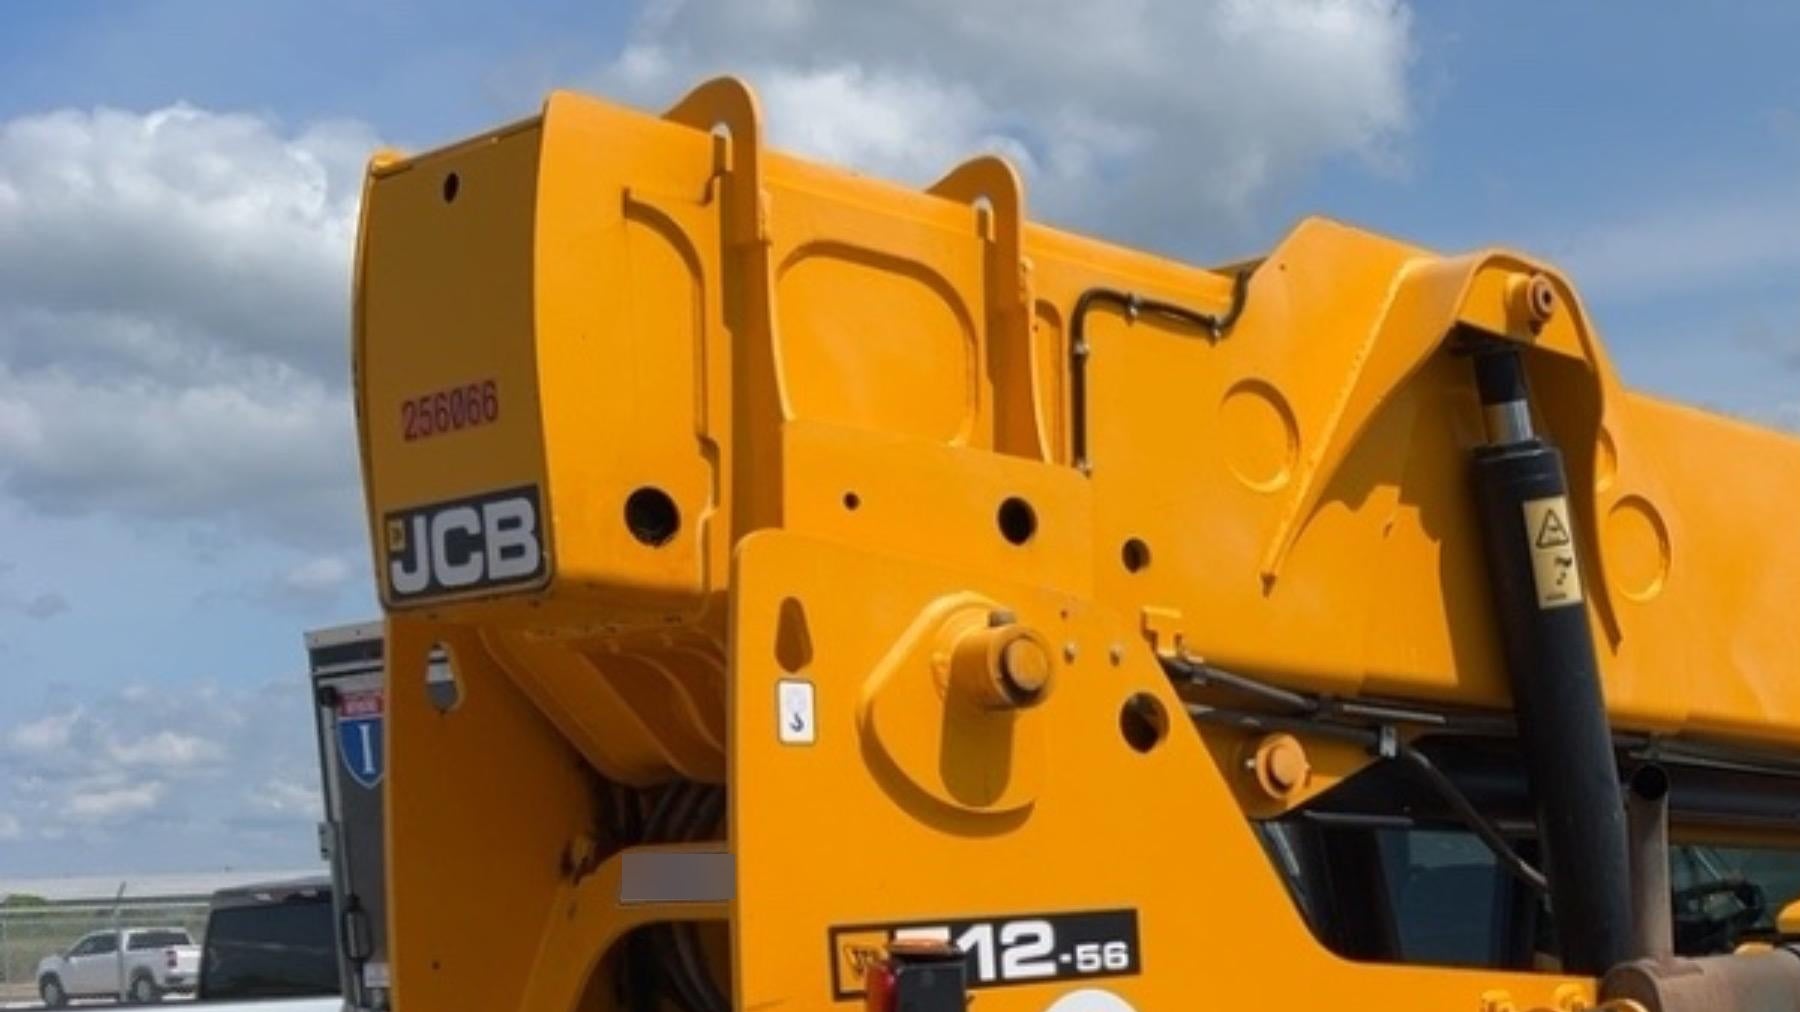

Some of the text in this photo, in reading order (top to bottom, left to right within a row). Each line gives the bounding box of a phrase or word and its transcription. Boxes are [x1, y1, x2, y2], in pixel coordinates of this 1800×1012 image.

[402, 379, 498, 443] 256066
[391, 497, 540, 595] JCB
[895, 919, 1130, 982] 12-56
